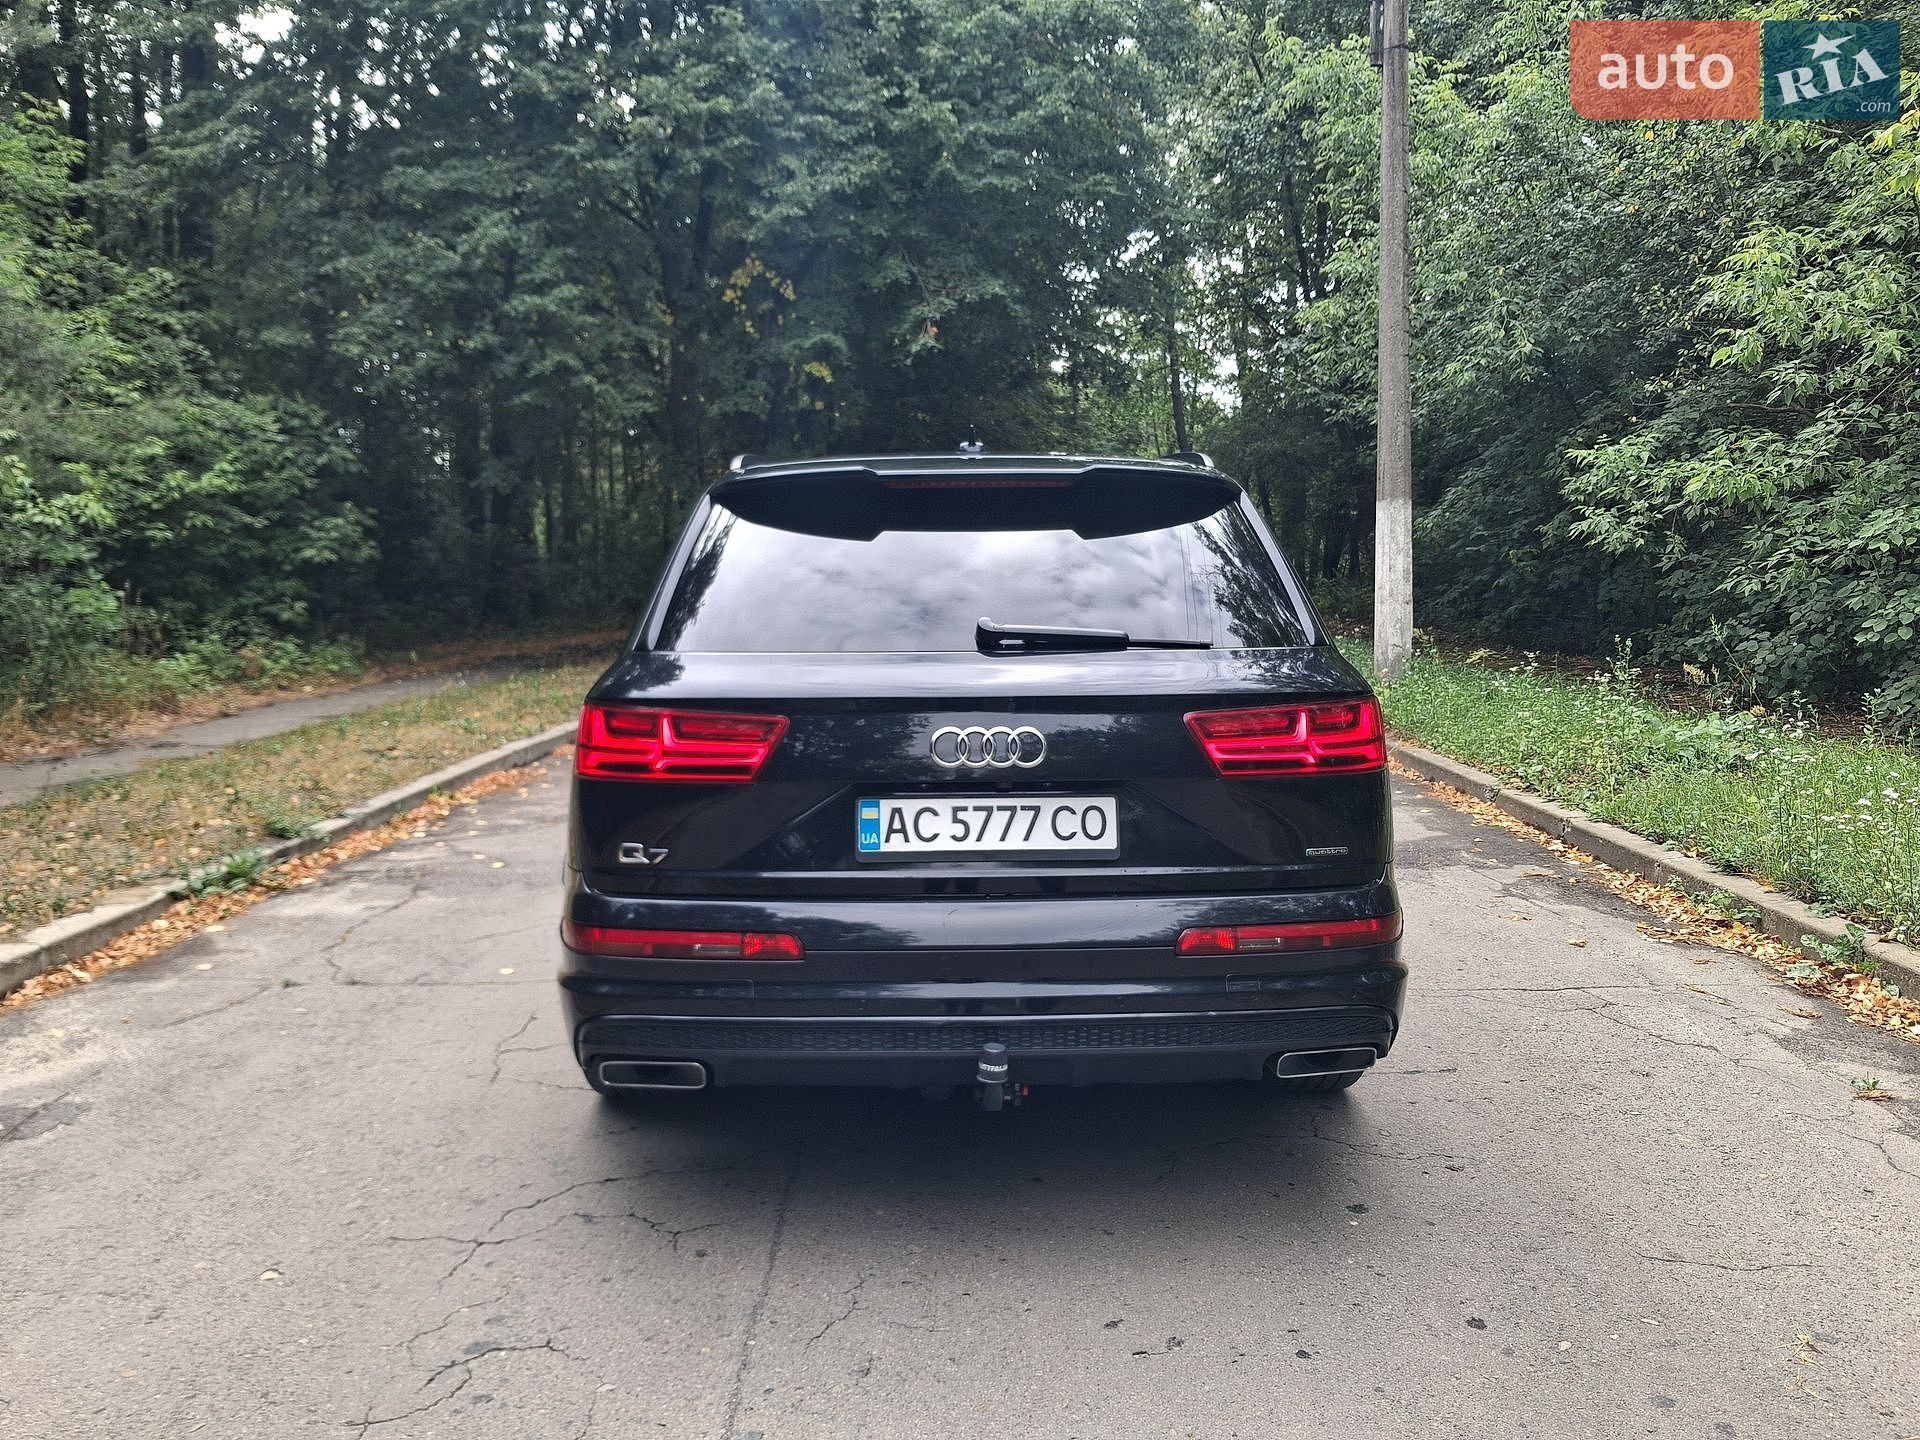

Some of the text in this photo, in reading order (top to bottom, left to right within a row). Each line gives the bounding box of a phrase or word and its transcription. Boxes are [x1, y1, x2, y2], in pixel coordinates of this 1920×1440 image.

[884, 805, 1107, 843] AC 5777 CO
[861, 832, 879, 844] UA
[618, 842, 669, 864] Q7
